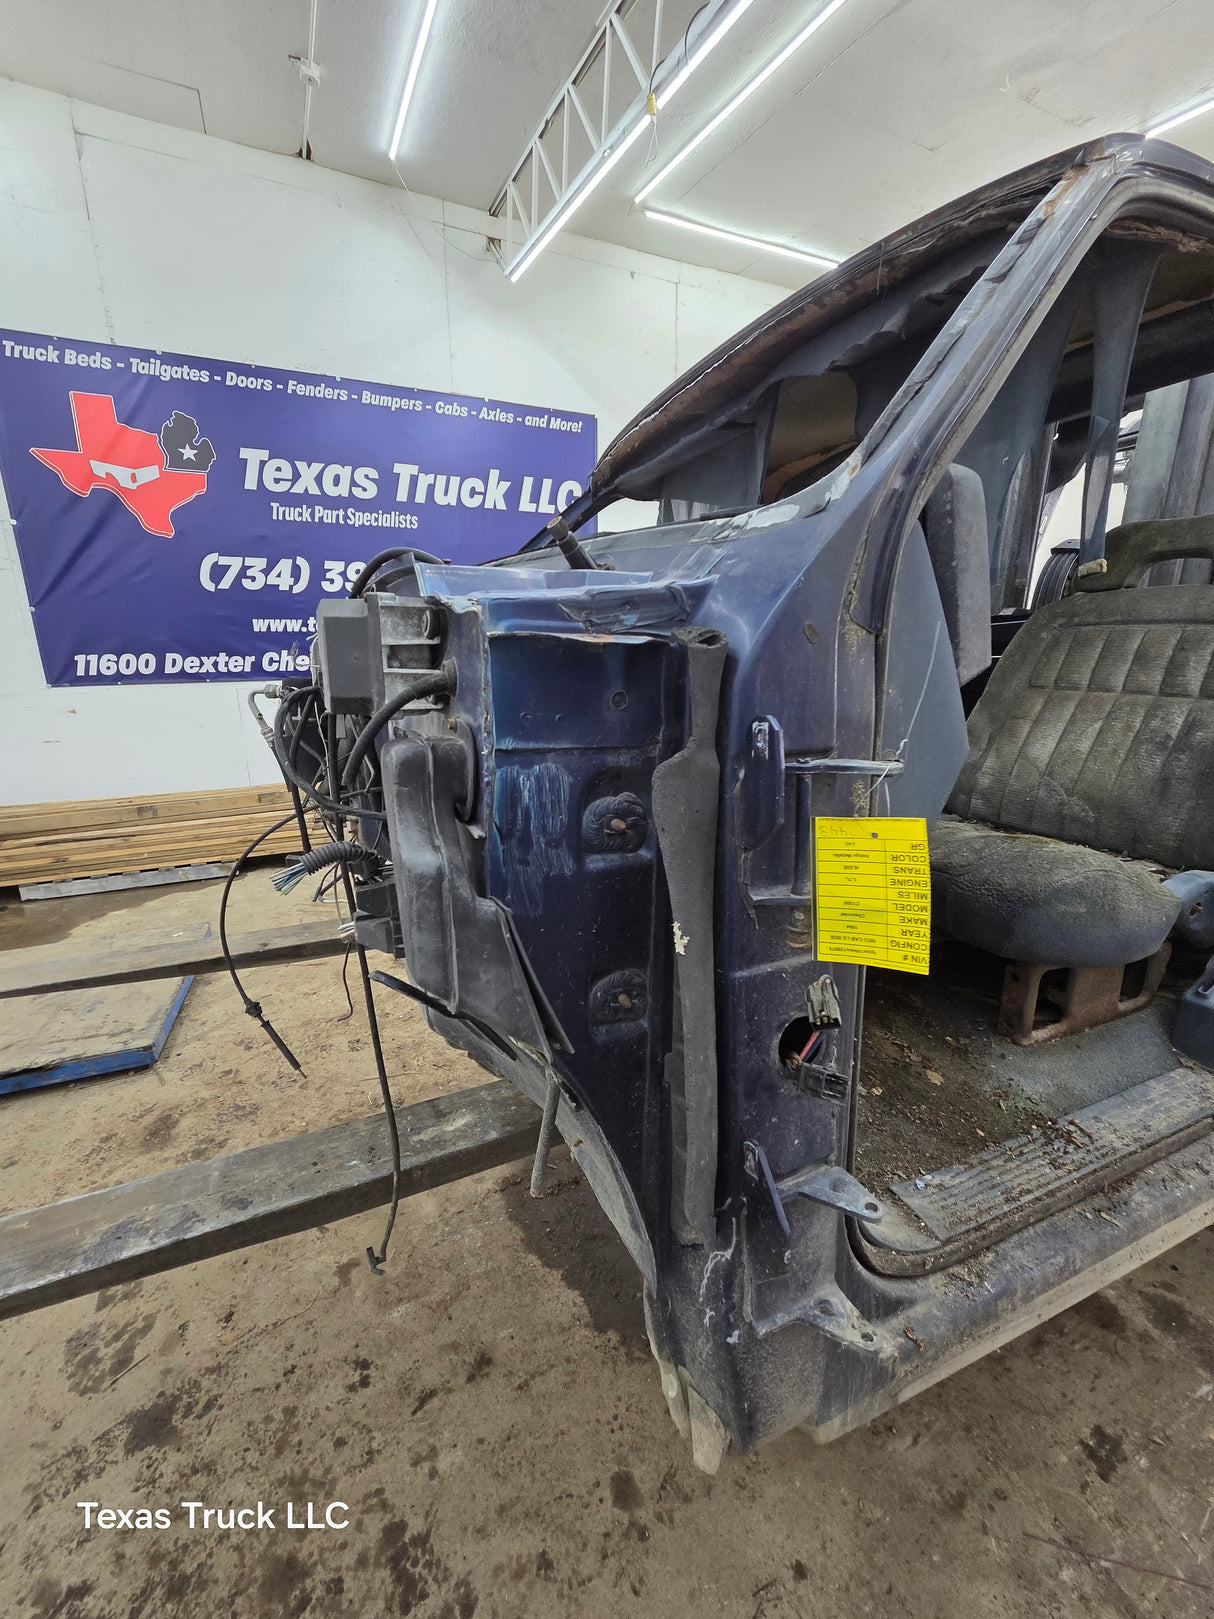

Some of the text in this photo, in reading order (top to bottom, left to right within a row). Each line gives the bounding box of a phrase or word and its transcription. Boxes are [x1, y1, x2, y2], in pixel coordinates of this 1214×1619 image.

[2, 340, 59, 364] Truck
[64, 348, 112, 370] Beds
[129, 358, 210, 382] Tailgates
[225, 371, 273, 392] Doors
[287, 379, 348, 402] Fenders
[361, 390, 423, 412] Bumpers
[435, 401, 468, 417] Cabs
[478, 407, 514, 424] Axles
[524, 413, 548, 429] and
[549, 417, 583, 433] More!
[239, 447, 583, 514] Texas Truck LLC
[270, 502, 419, 530] Truck Part Specialists
[199, 552, 310, 594] (734)
[252, 616, 318, 633] www.t
[74, 653, 157, 676] 11600
[164, 651, 256, 674] Dexter
[911, 843, 926, 851] GR
[891, 854, 926, 863] COLOR
[893, 866, 928, 875] TRANS
[890, 878, 928, 888] ENGINE
[898, 891, 929, 900] MILES
[892, 902, 928, 913] MODEL
[899, 915, 928, 926] MAKE
[901, 929, 928, 938] YEAR
[890, 939, 928, 952] CONFIG
[911, 954, 927, 964] VIN
